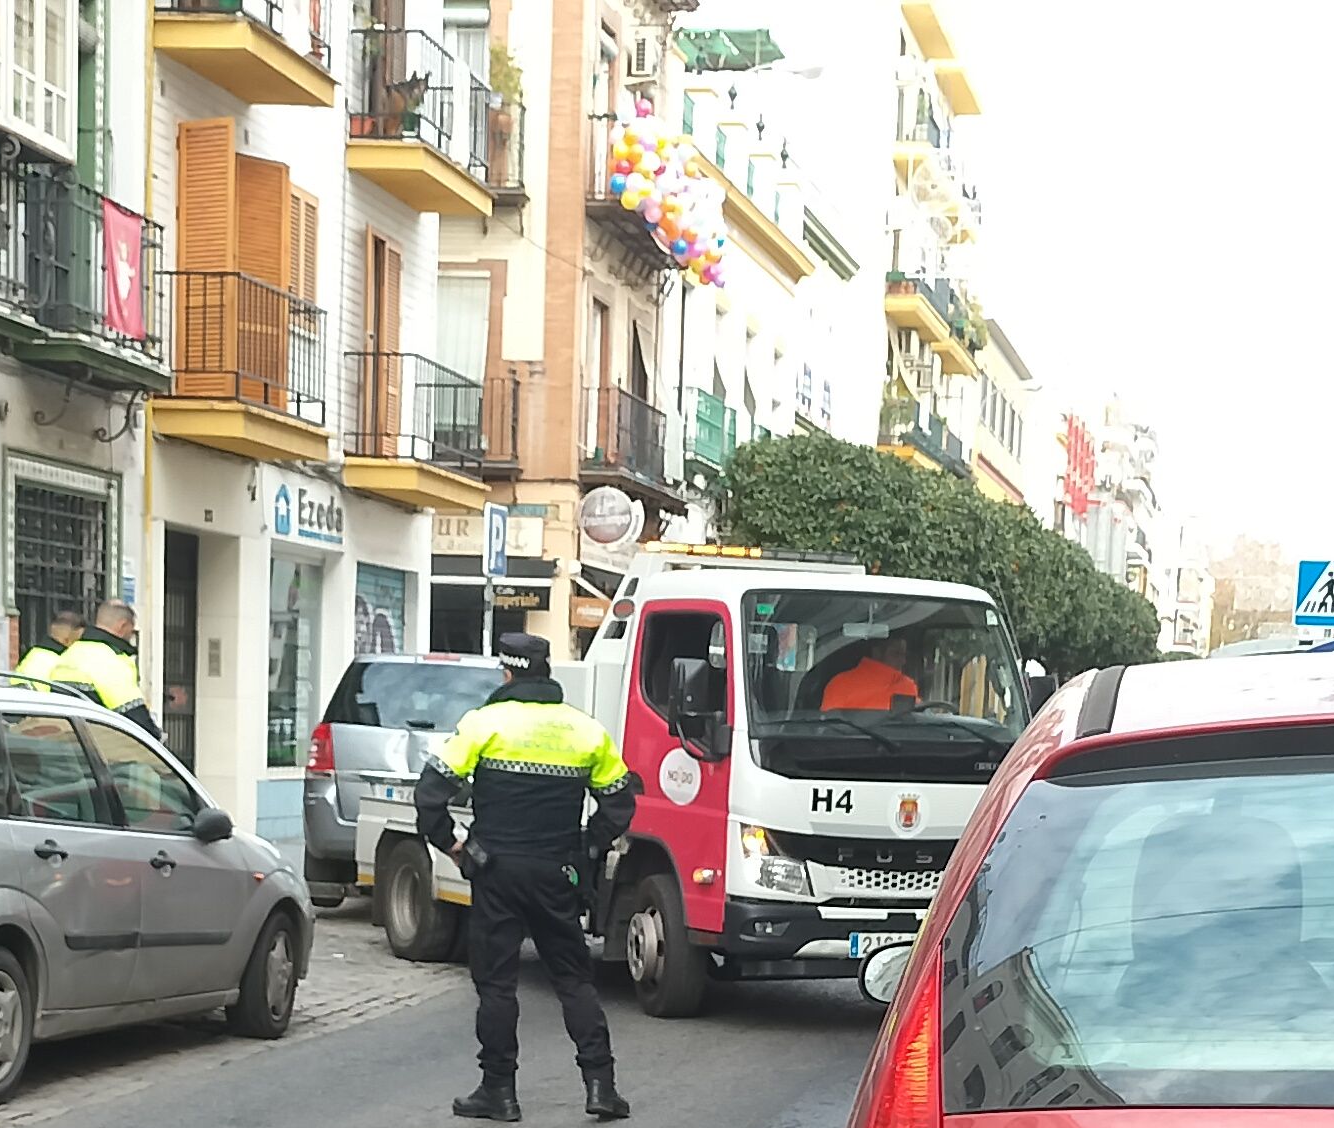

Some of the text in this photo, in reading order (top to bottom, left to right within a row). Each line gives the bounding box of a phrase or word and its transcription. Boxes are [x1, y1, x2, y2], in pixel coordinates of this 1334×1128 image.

[298, 488, 343, 532] Ezeda
[489, 513, 504, 571] P
[811, 788, 854, 814] H4
